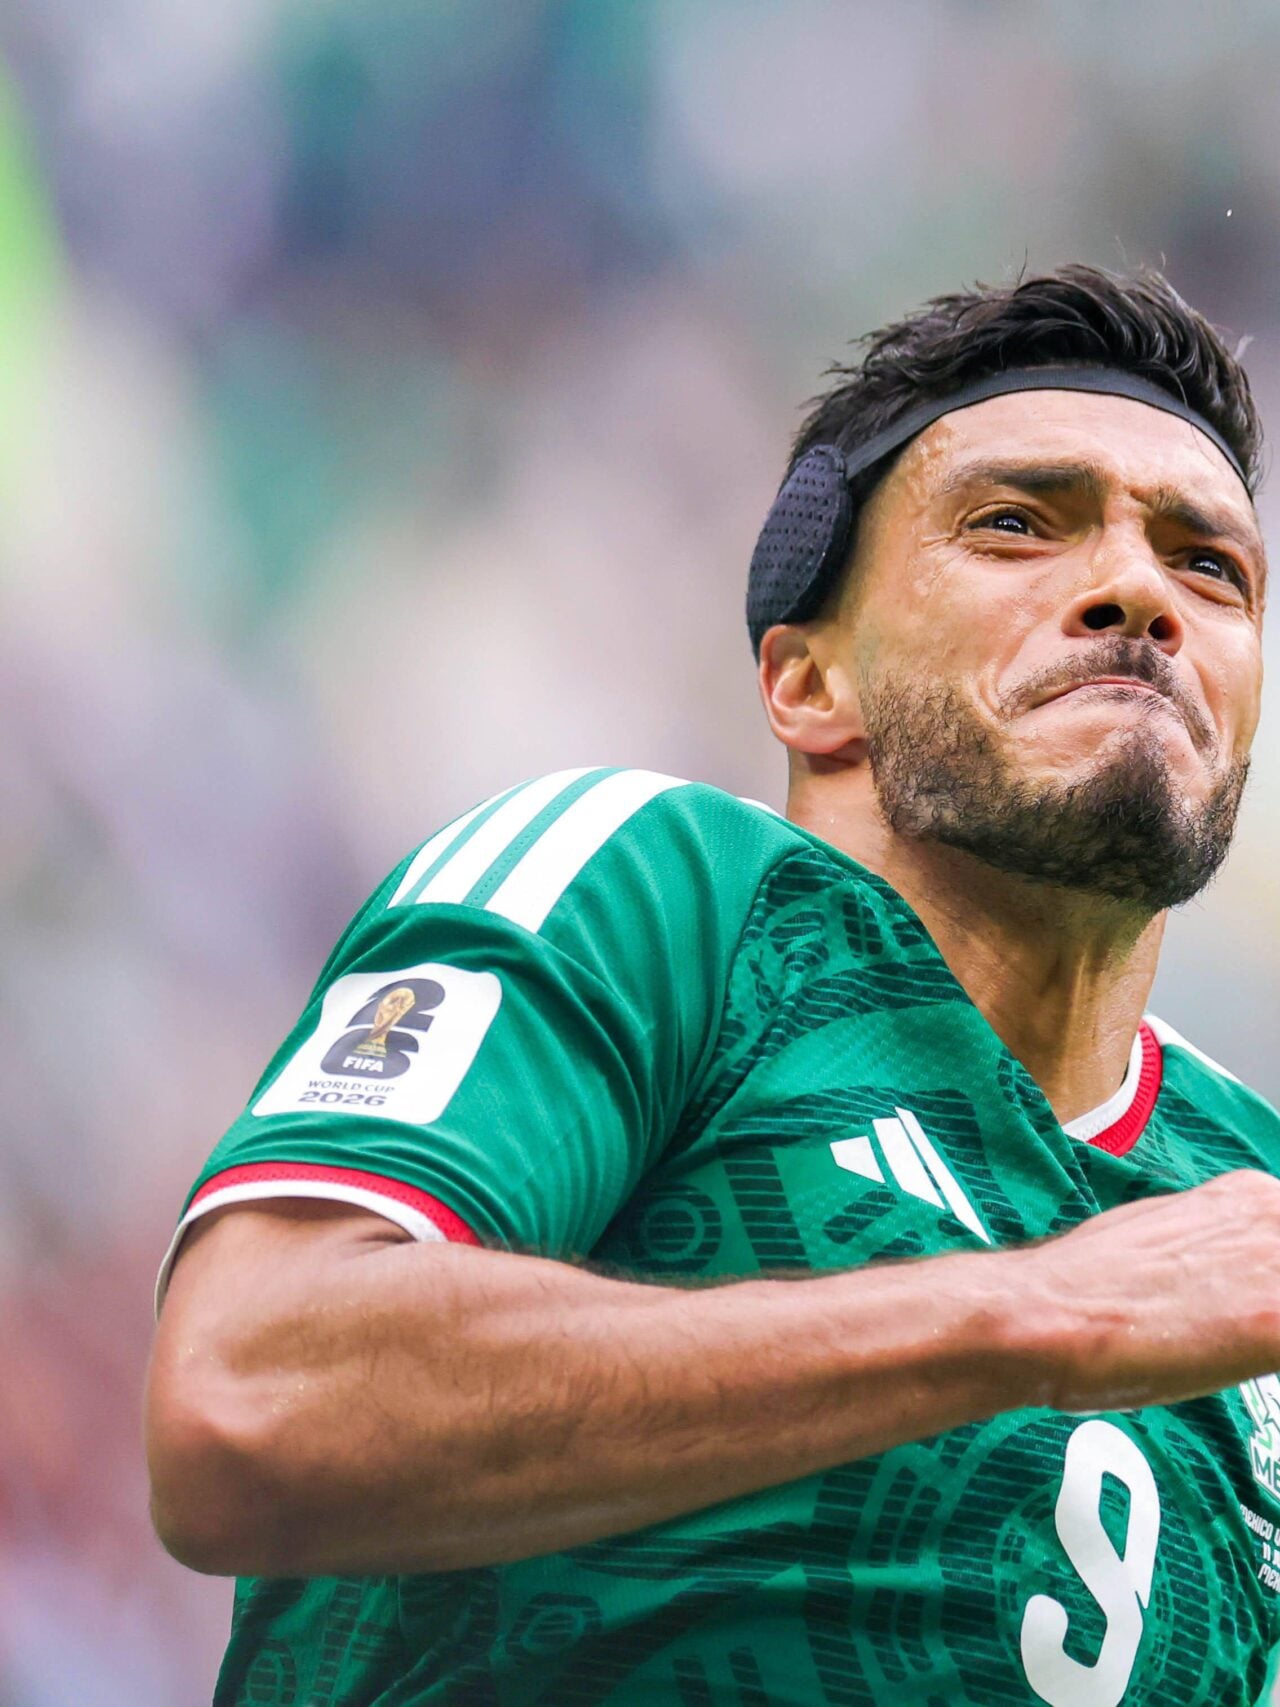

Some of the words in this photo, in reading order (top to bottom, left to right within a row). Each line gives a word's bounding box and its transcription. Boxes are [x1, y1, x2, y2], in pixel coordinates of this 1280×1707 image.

[342, 1056, 384, 1073] FIFA
[308, 1080, 362, 1091] WORLD
[364, 1084, 396, 1093] CUP
[298, 1091, 388, 1107] 2026
[1020, 1419, 1161, 1707] 9
